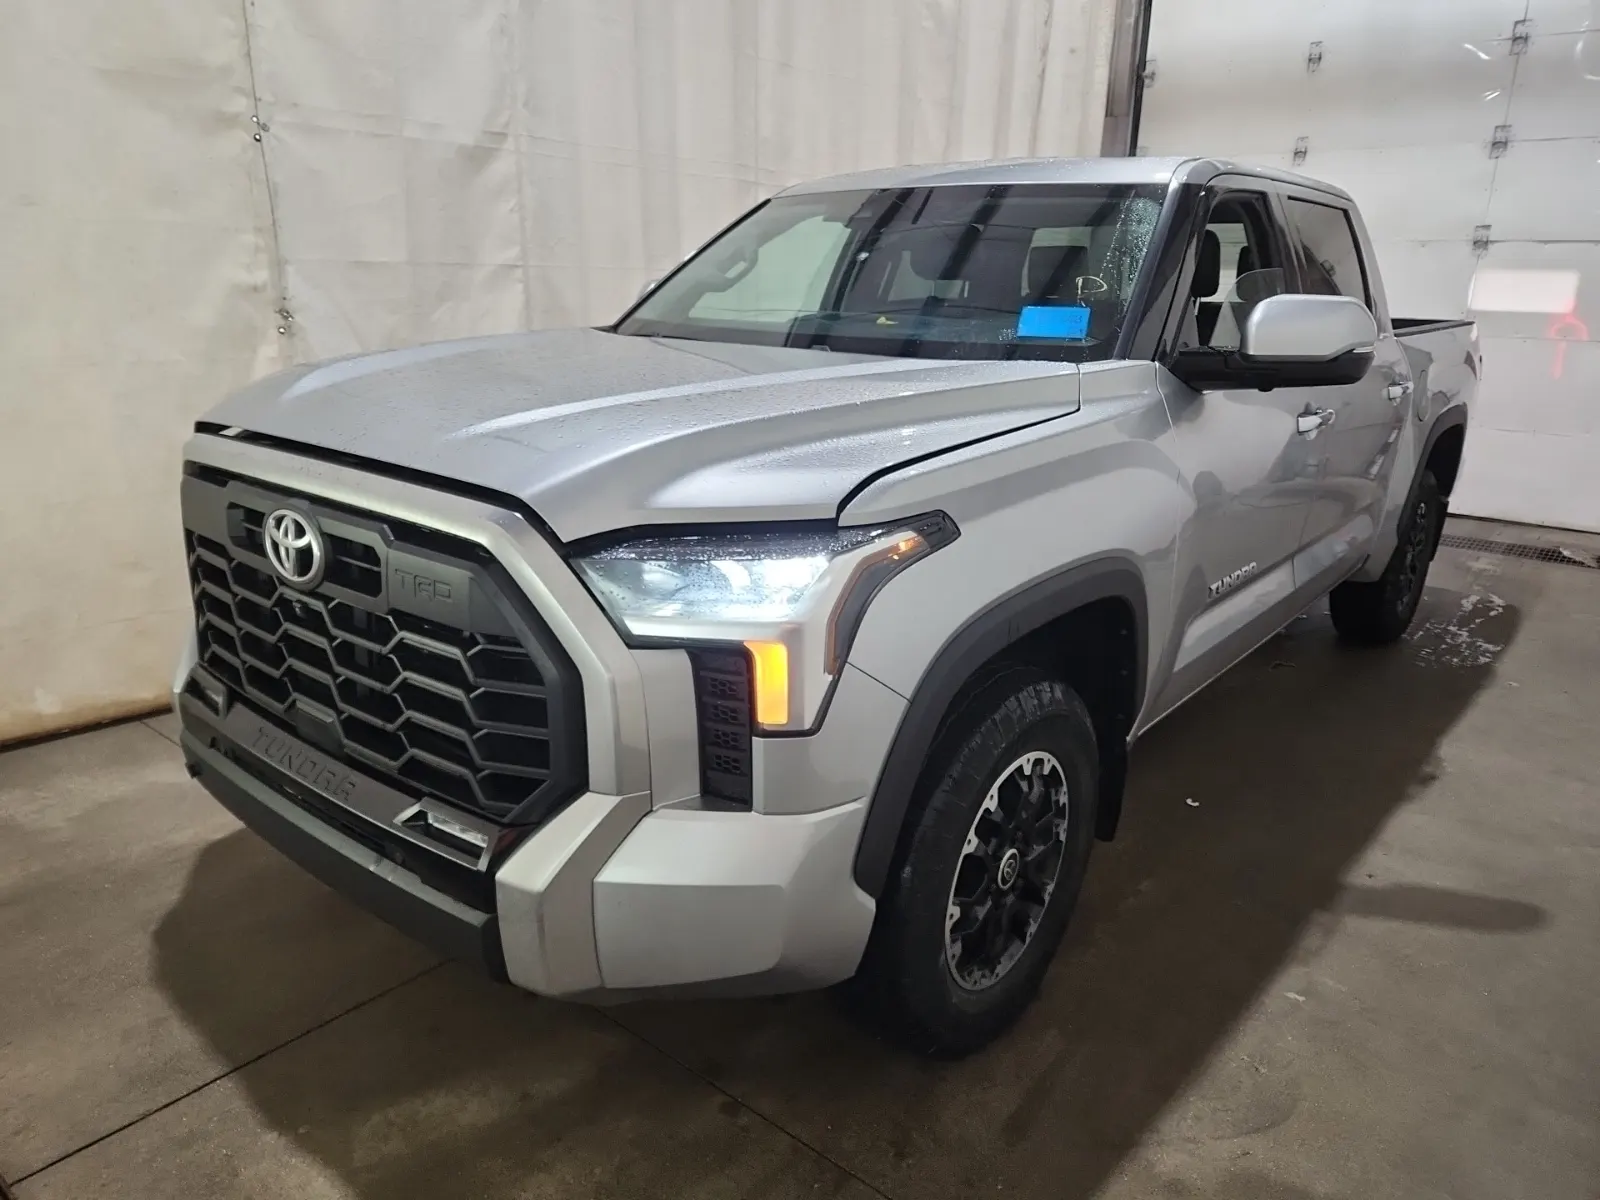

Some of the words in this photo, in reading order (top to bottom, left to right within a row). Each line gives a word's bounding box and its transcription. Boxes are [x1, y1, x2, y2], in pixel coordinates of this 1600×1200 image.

[394, 568, 453, 602] TRD
[1207, 561, 1258, 599] TUNDRA
[251, 725, 357, 802] TUNDRA
